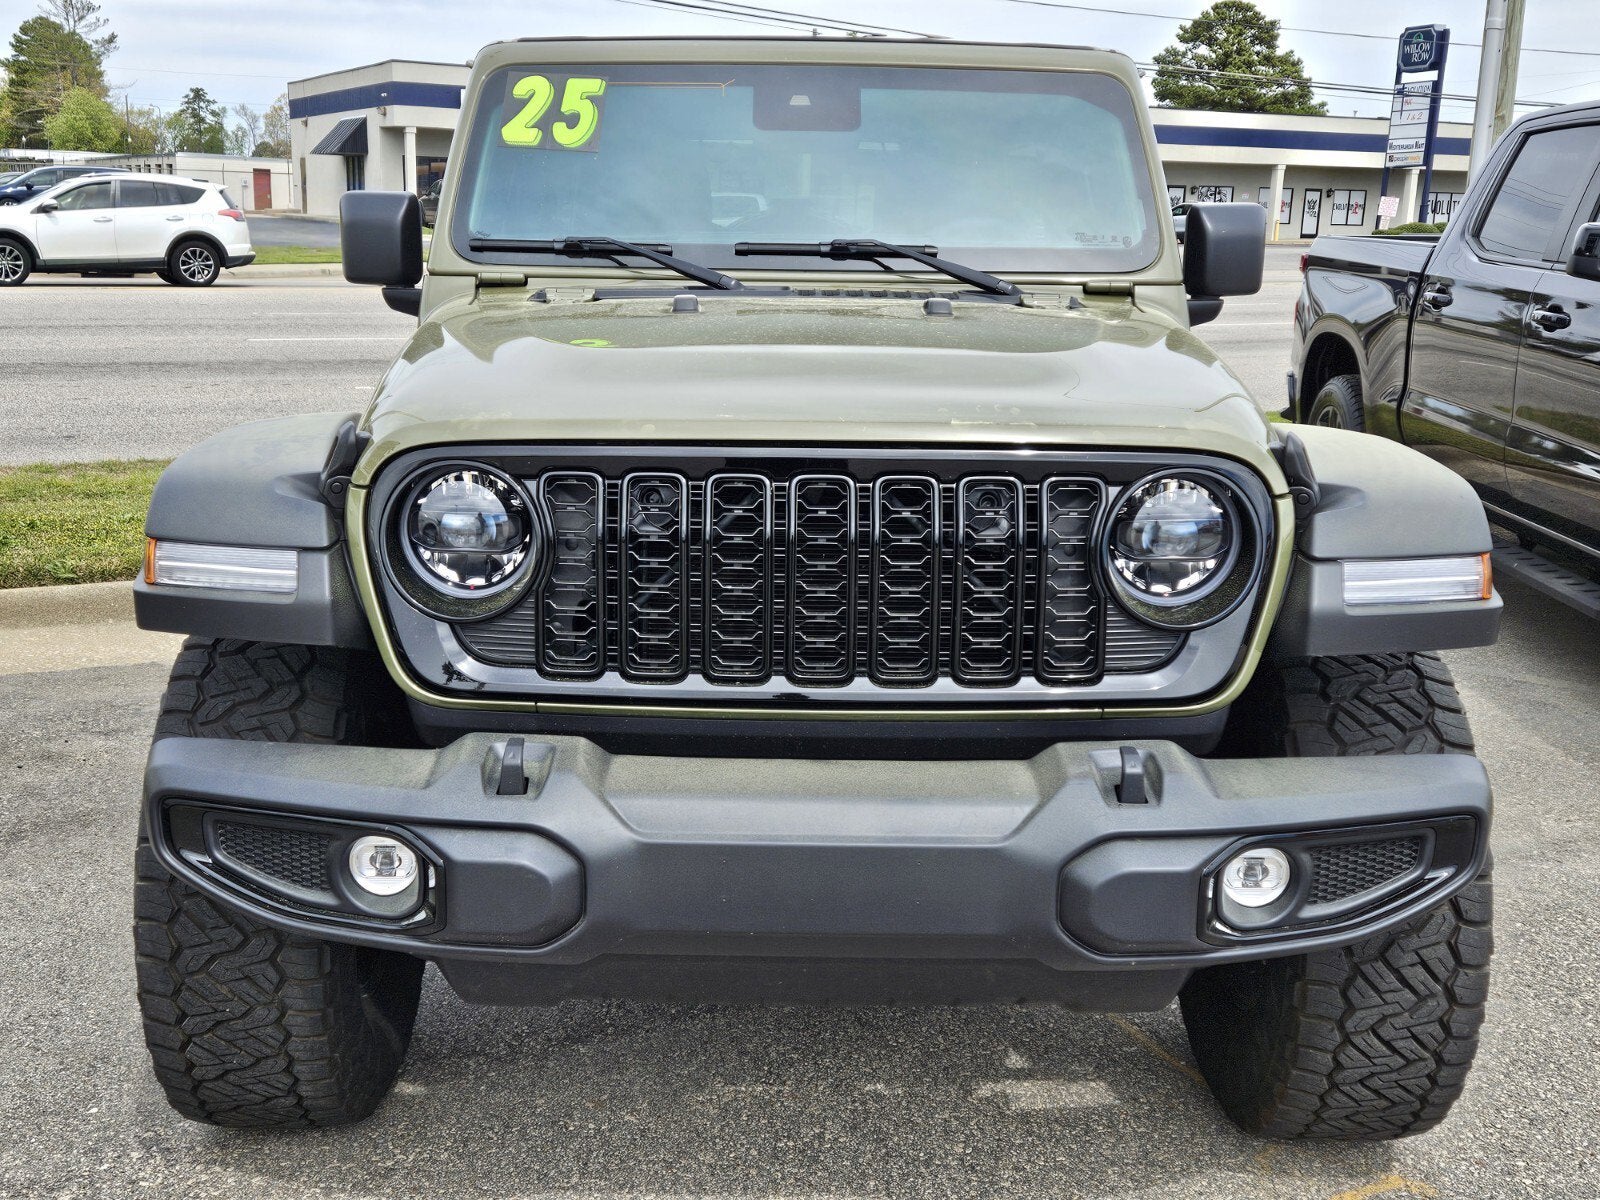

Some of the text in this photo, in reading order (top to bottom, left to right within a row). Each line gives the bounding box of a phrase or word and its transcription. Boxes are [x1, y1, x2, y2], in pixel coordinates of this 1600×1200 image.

[1411, 51, 1431, 62] ROW
[501, 75, 606, 148] 25
[1416, 111, 1424, 120] 2
